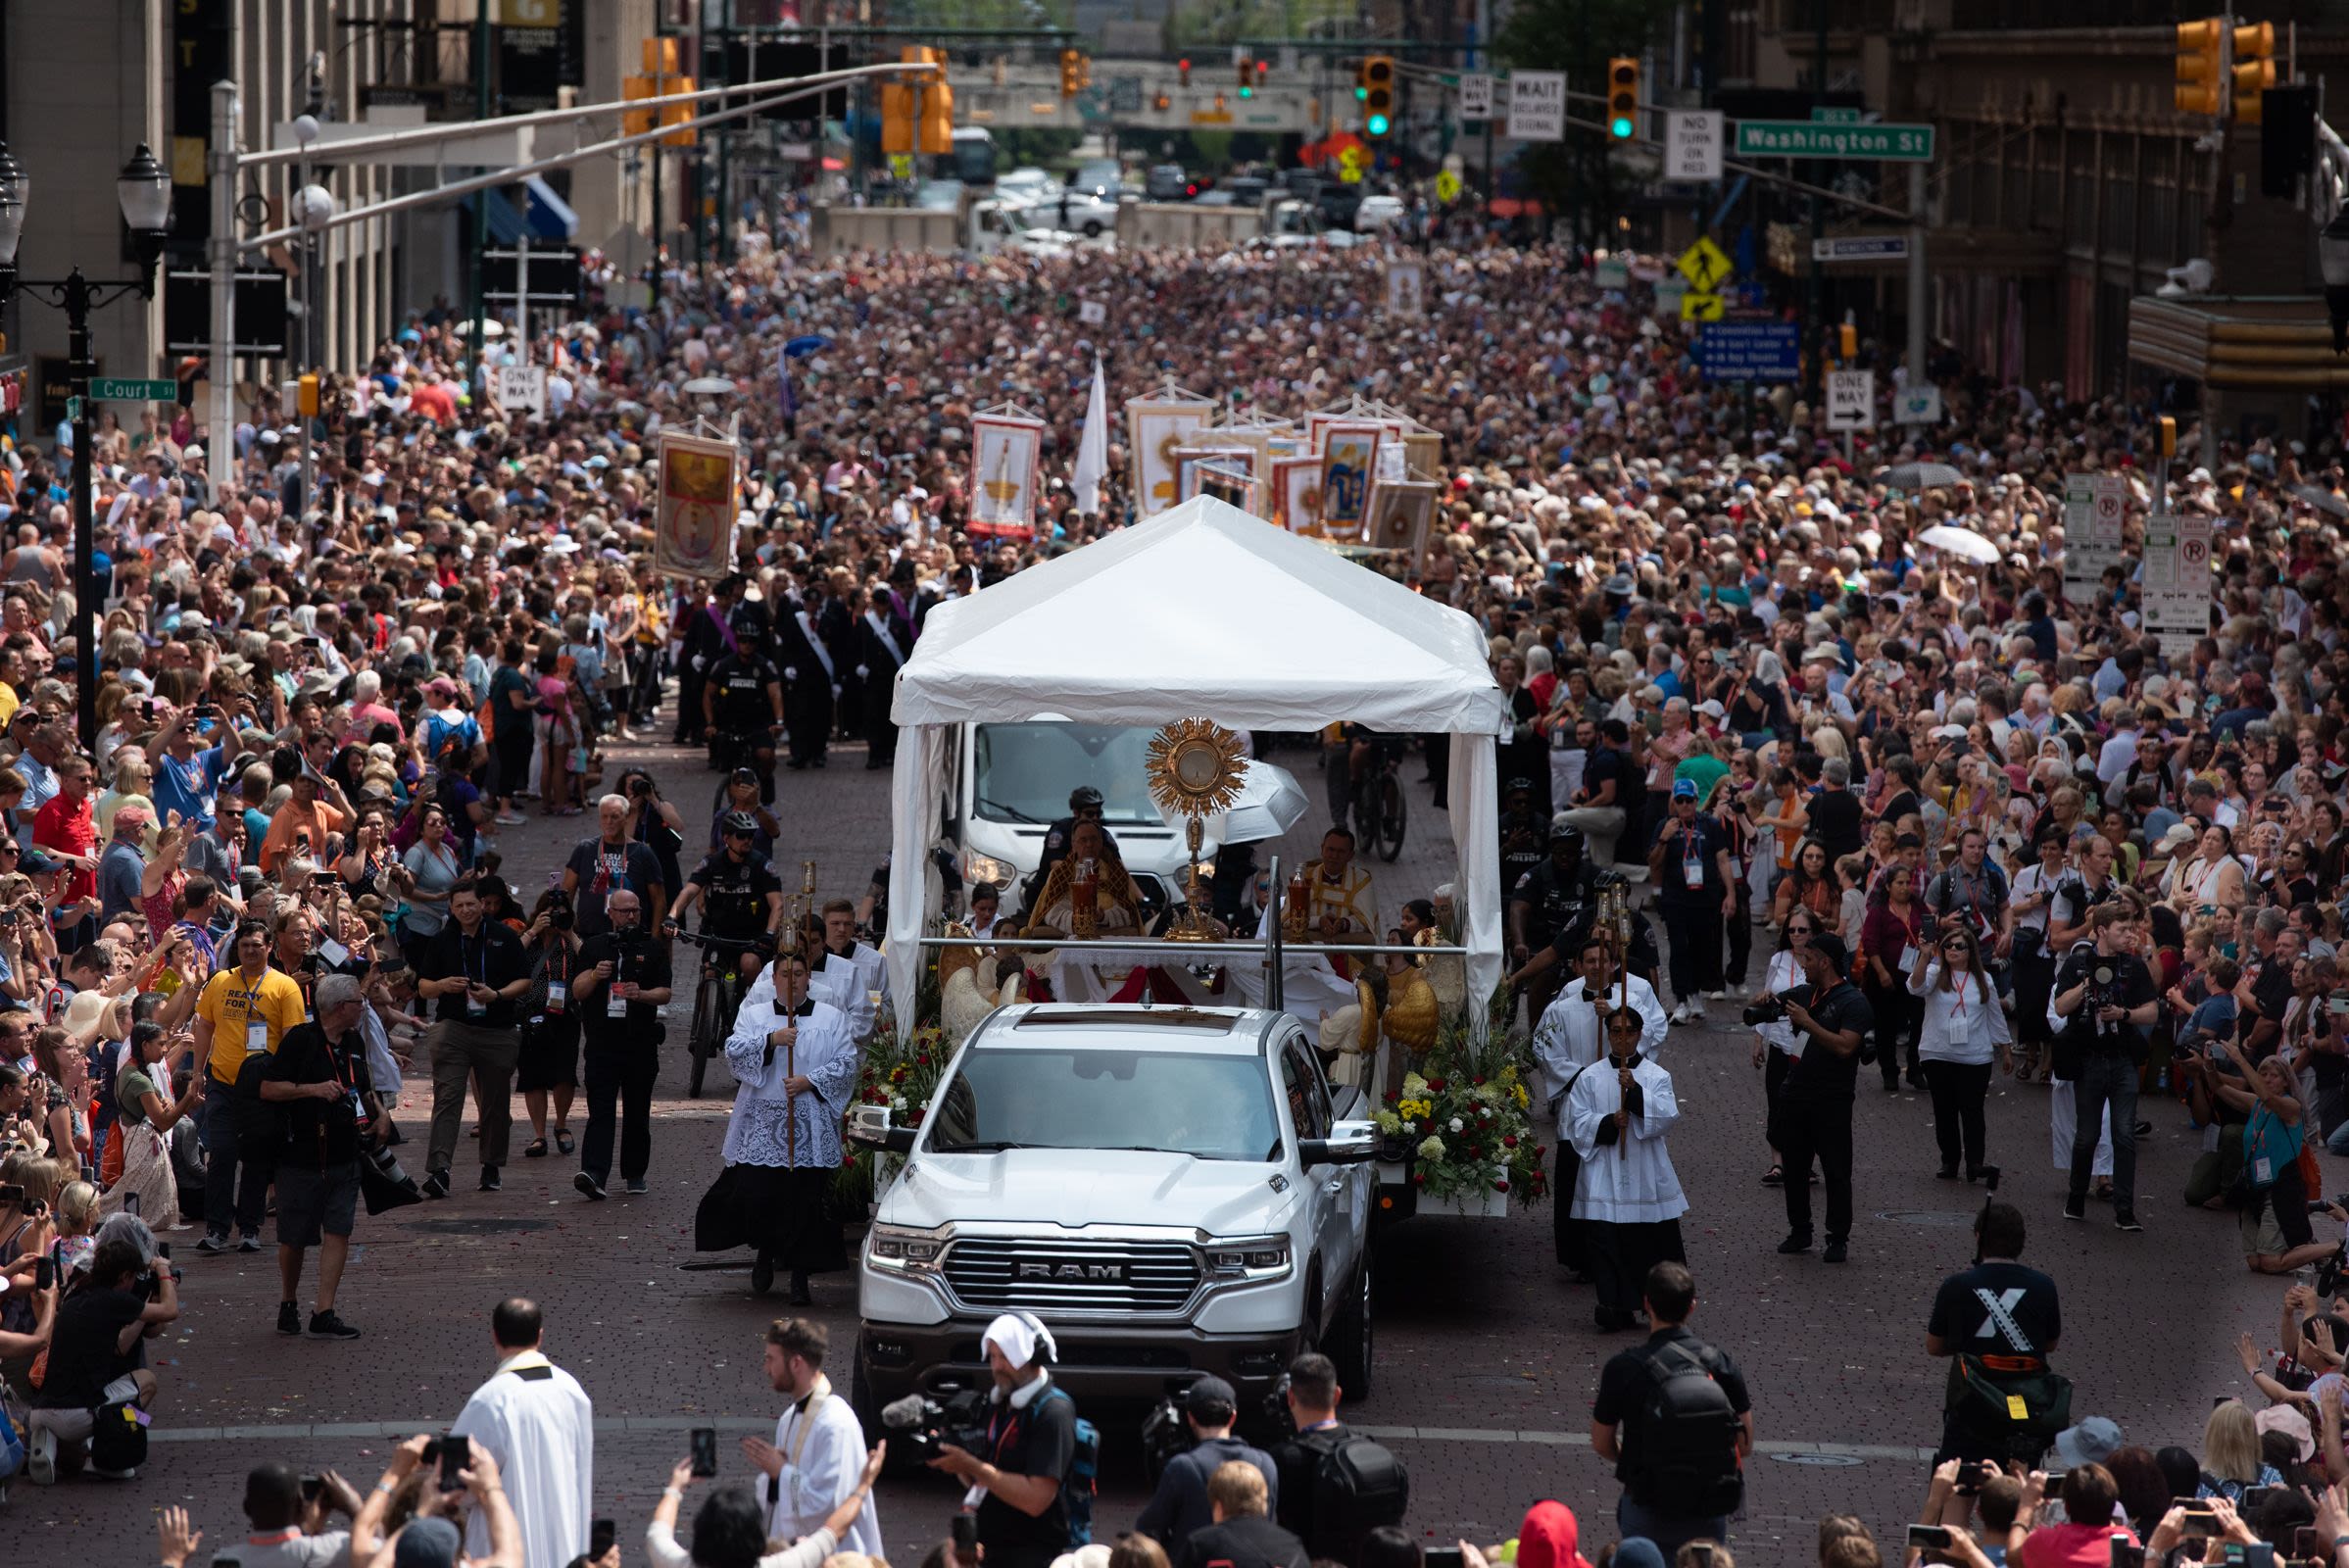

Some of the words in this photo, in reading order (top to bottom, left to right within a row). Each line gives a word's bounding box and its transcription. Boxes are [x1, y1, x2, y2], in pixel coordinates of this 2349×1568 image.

[1515, 80, 1561, 97] WAIT
[1514, 103, 1560, 115] DELAYED
[1516, 120, 1554, 132] SIGNAL
[1682, 116, 1708, 129] NO
[1678, 131, 1712, 144] TURN
[1745, 127, 1888, 153] Washington
[1898, 132, 1924, 152] St
[1685, 146, 1705, 159] ON
[1681, 161, 1707, 173] RED
[506, 369, 535, 383] ONE
[1835, 374, 1864, 388] ONE
[104, 381, 151, 400] Court
[507, 386, 537, 399] WAY
[1835, 392, 1866, 404] WAY
[225, 999, 247, 1008] FOR
[1019, 1262, 1122, 1279] RAM
[1973, 1288, 2034, 1351] X
